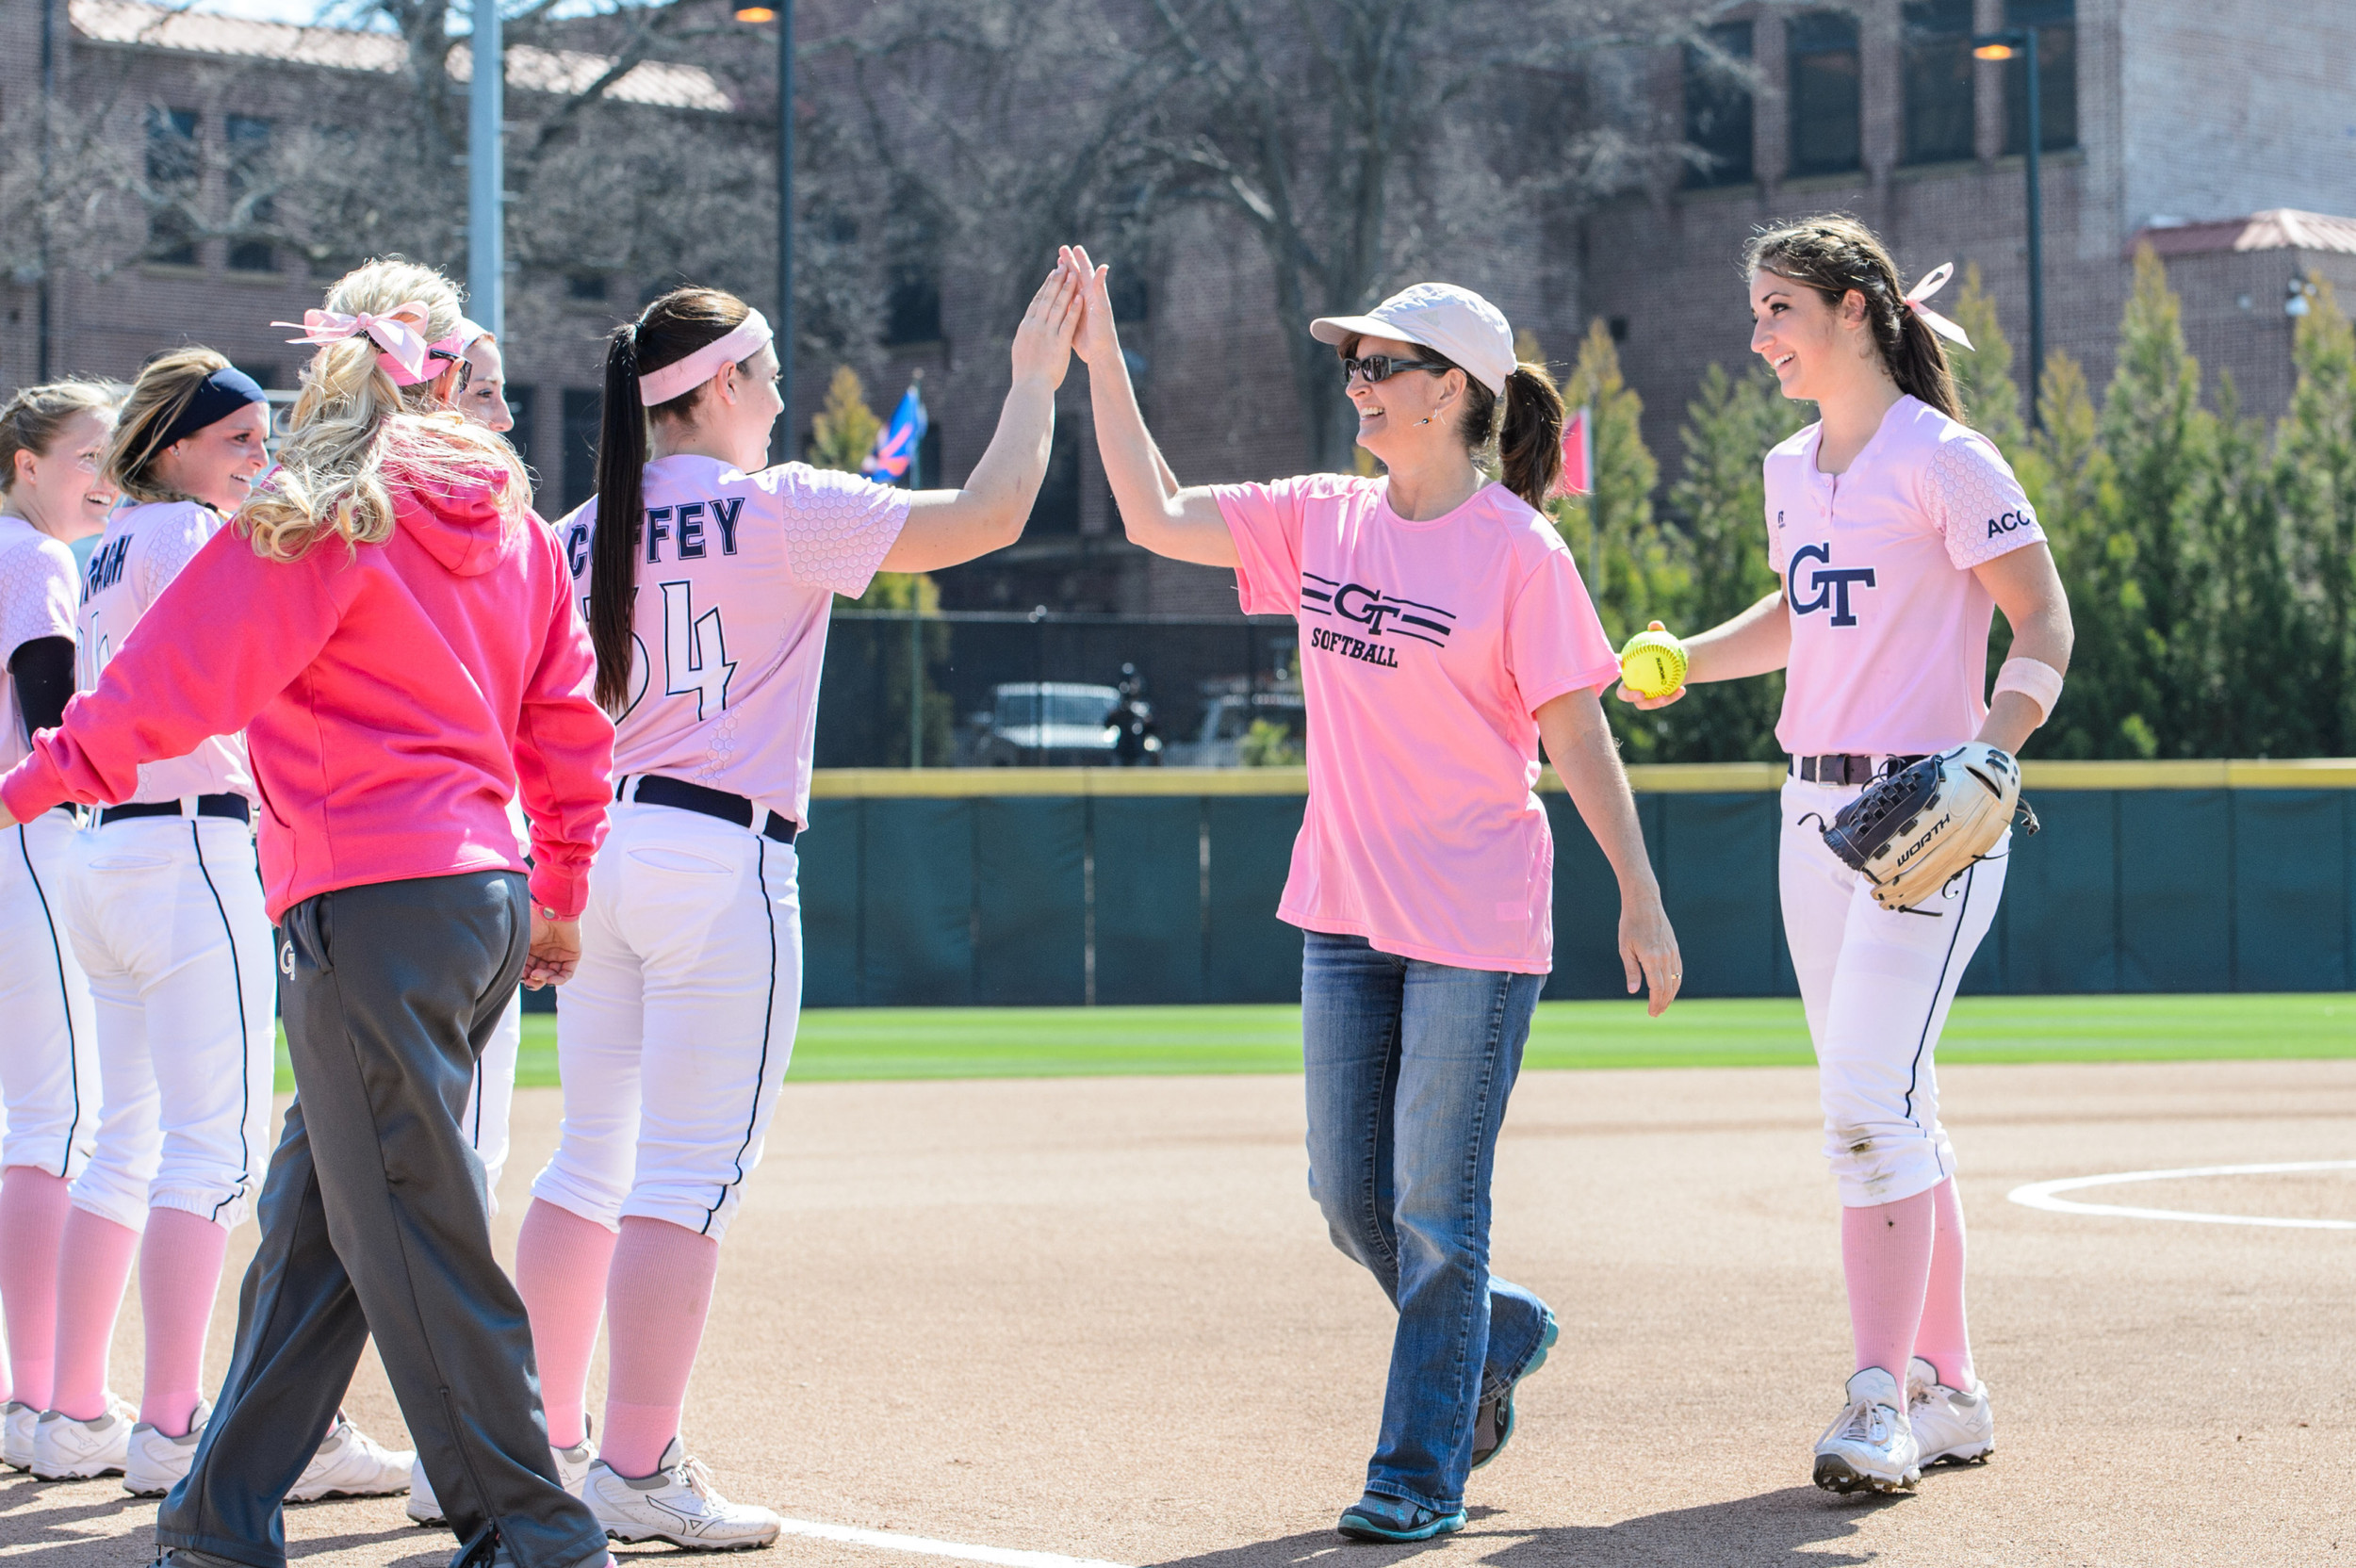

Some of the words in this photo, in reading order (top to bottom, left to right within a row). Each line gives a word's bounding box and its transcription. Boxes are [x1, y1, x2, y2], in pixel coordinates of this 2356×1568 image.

[566, 498, 744, 580] CFEY
[1988, 510, 2030, 538] ACC
[1334, 583, 1400, 636] GT
[1789, 541, 1876, 628] GT
[1311, 627, 1398, 668] SOFTBALL
[1897, 813, 1950, 867] WORTH
